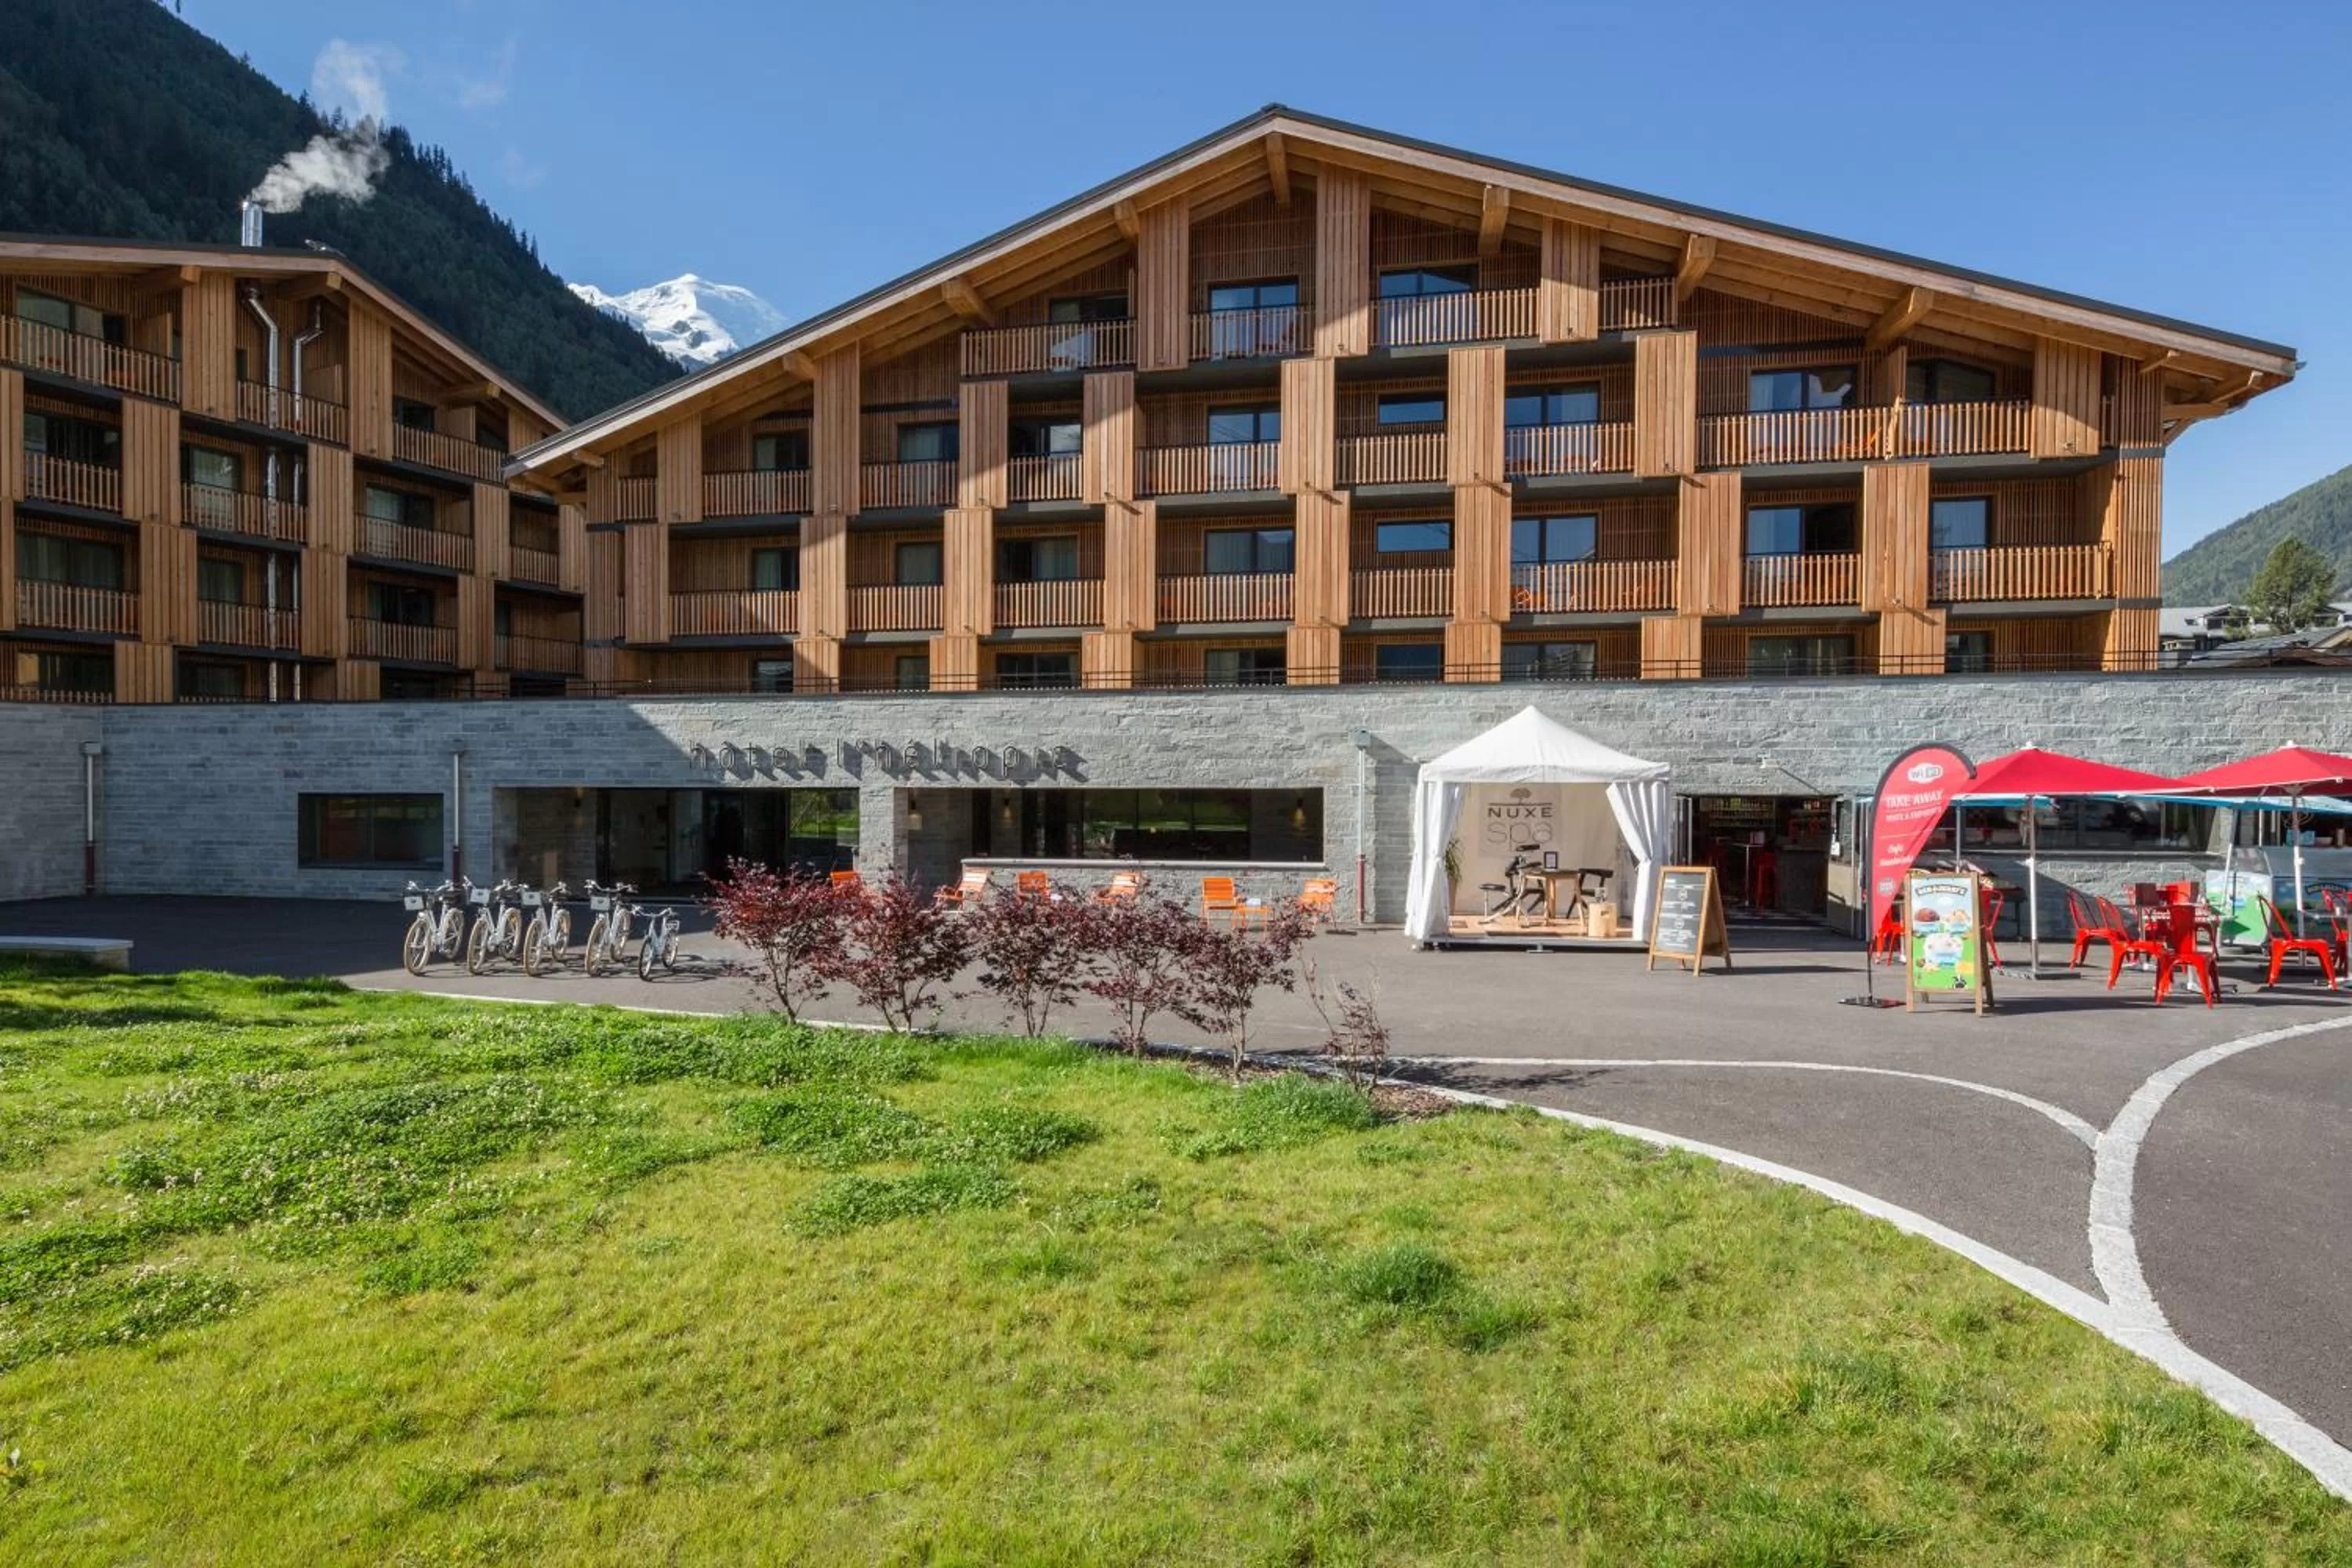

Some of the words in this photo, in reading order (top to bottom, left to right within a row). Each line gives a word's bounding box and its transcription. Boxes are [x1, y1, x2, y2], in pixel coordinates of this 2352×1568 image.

[1886, 794, 1911, 808] TAKE
[1914, 789, 1944, 804] AWAY
[1487, 807, 1553, 818] NUXE
[1487, 821, 1553, 852] spa
